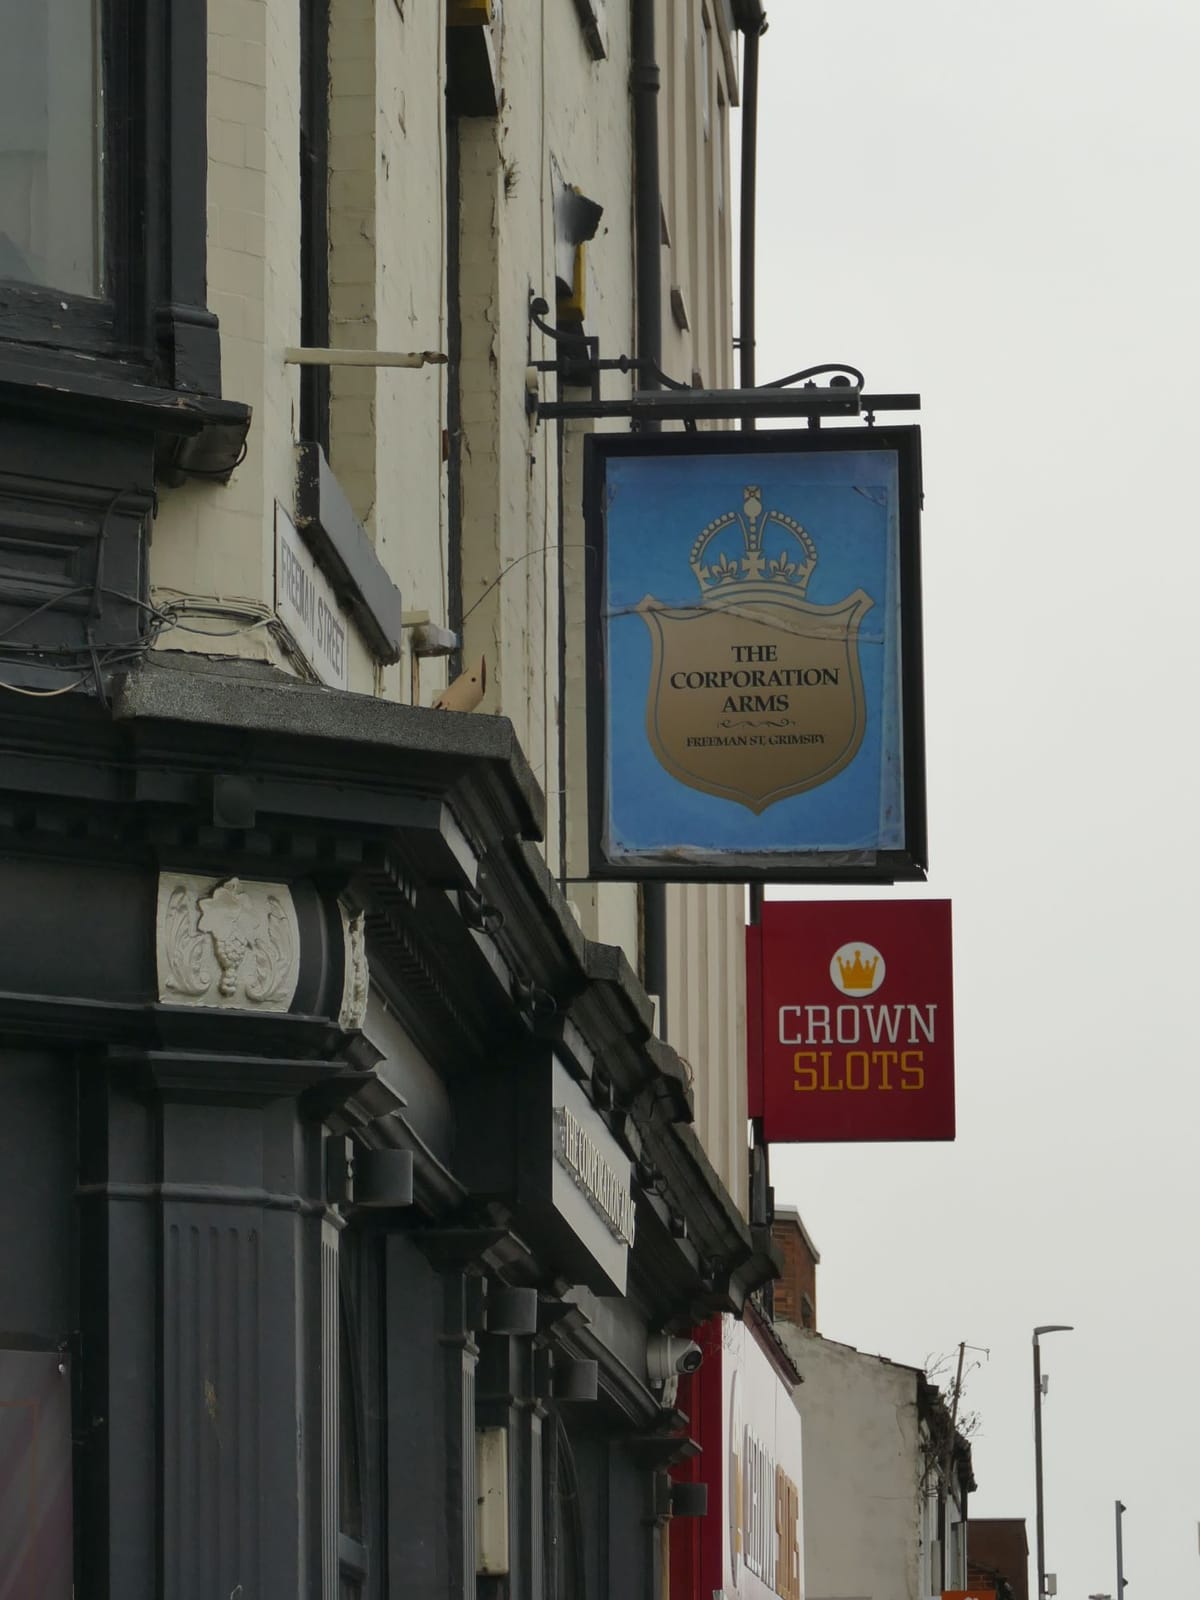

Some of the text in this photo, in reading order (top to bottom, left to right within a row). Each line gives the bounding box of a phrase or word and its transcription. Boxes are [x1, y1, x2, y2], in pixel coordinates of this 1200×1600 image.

[281, 536, 345, 681] FREEMAN STREET
[731, 645, 778, 663] THE
[670, 668, 840, 689] CORPORATION
[722, 694, 790, 713] ARMS
[686, 735, 747, 747] FREEMAN
[768, 733, 826, 746] GRIMSBY
[778, 1004, 938, 1044] CROWN
[793, 1050, 925, 1091] SLOTS
